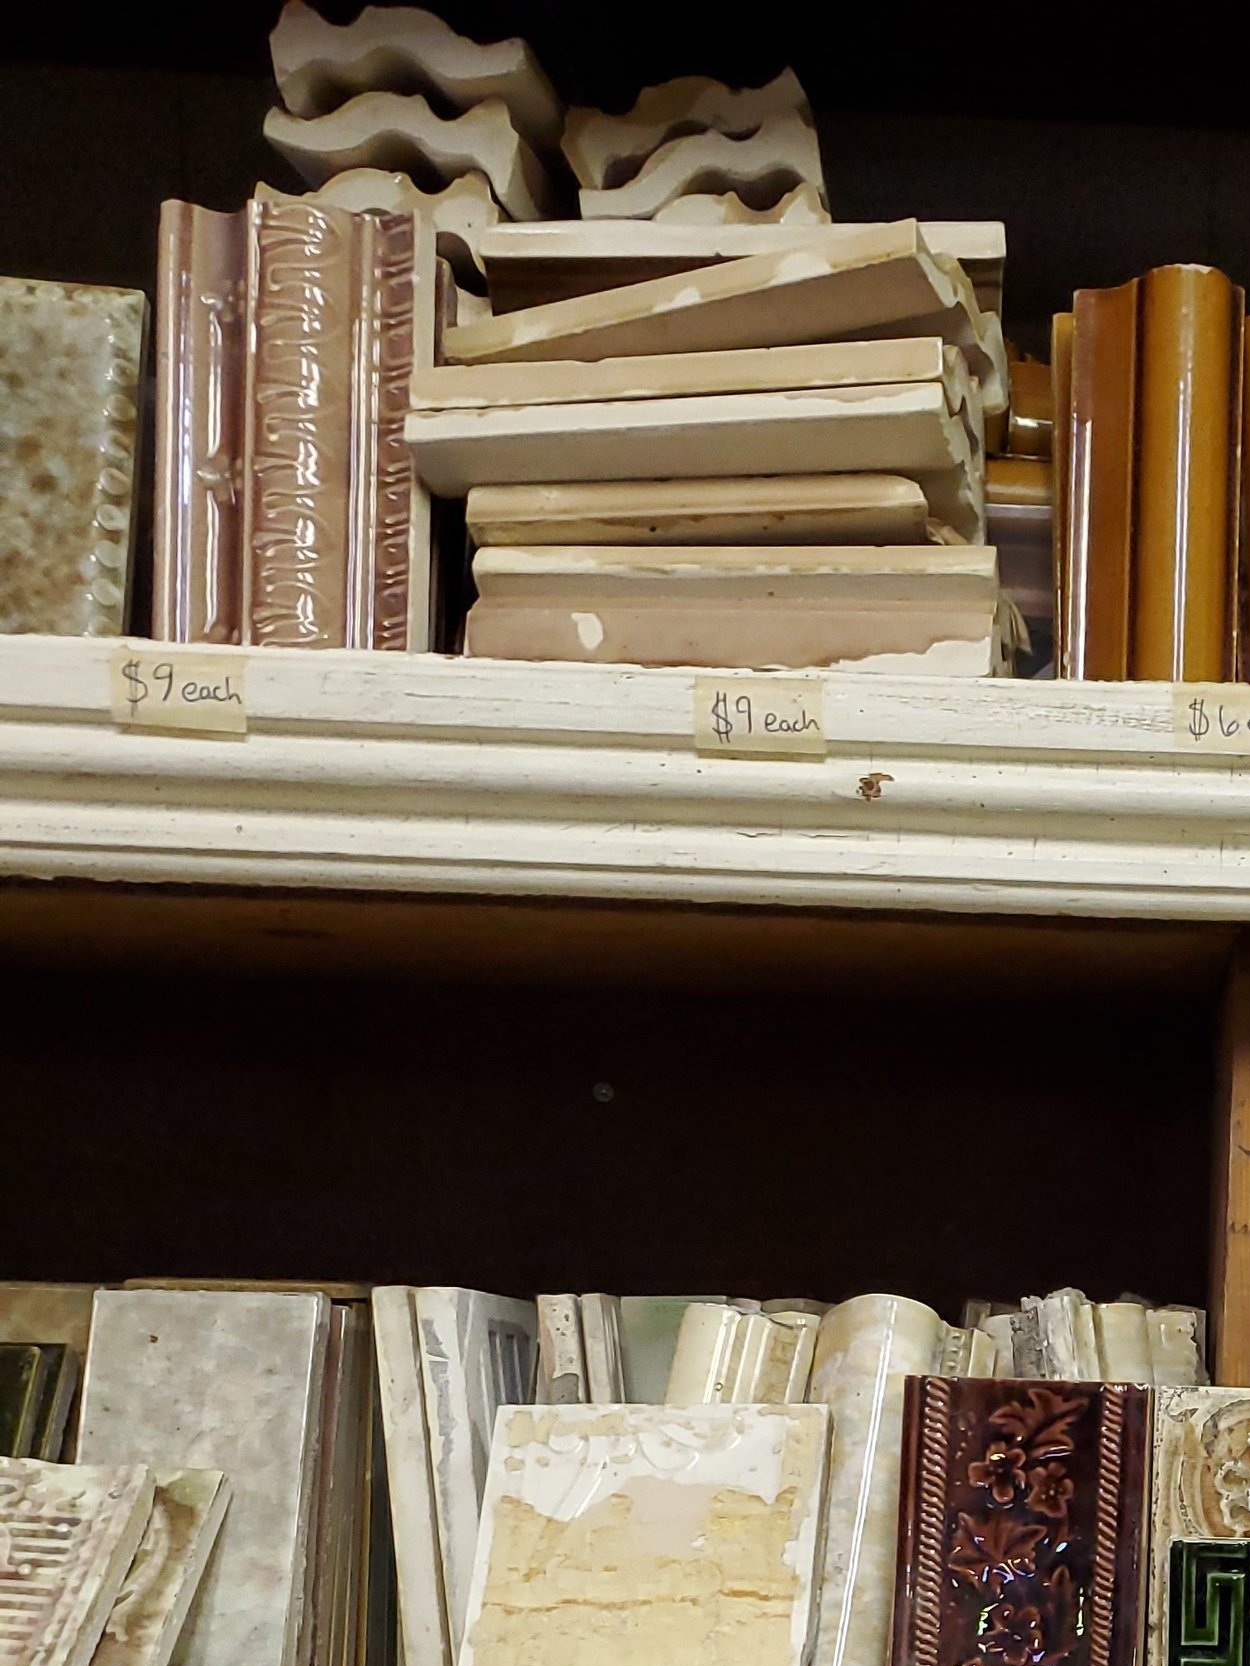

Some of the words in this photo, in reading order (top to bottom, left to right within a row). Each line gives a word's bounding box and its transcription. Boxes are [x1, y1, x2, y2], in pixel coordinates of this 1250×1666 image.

[121, 659, 174, 717] $9
[181, 677, 243, 704] each
[711, 691, 752, 744] $9
[764, 709, 820, 733] each
[1188, 698, 1240, 741] $6
